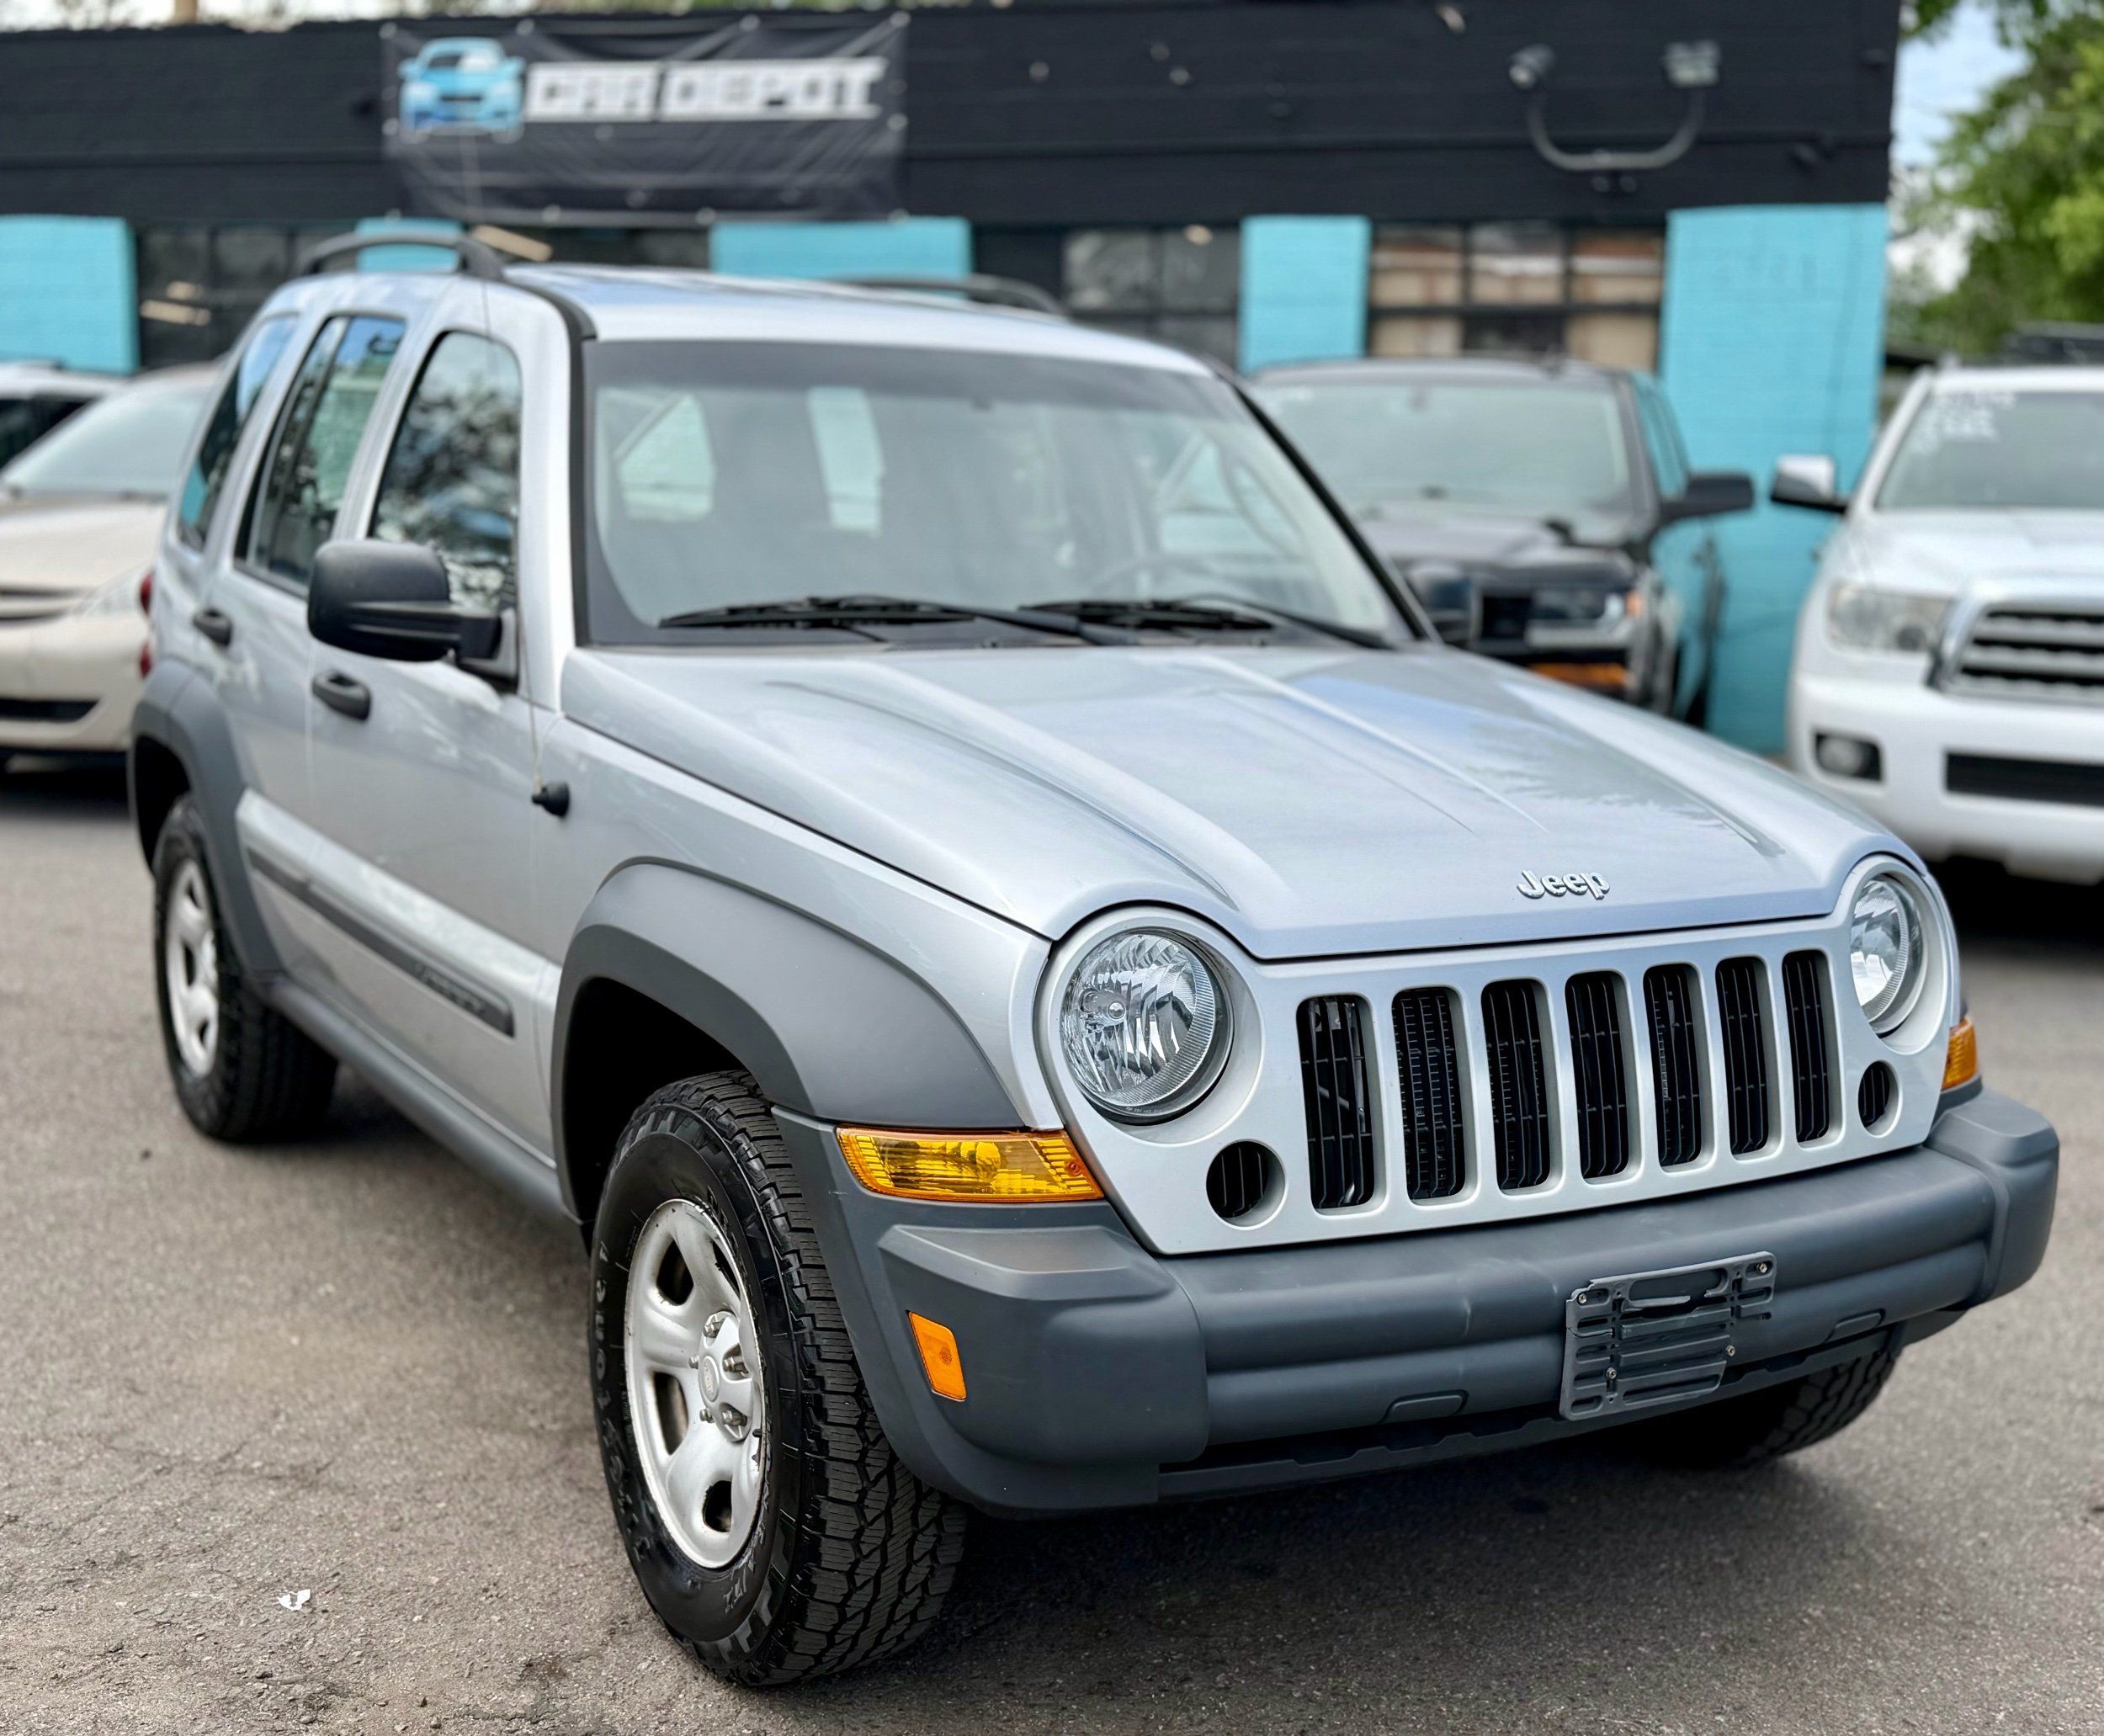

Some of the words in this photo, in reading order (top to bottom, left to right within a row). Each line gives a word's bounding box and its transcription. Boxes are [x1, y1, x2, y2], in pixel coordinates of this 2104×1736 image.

[524, 62, 660, 121] CAR
[660, 57, 887, 120] DEPOT
[1517, 869, 1610, 900] Jeep
